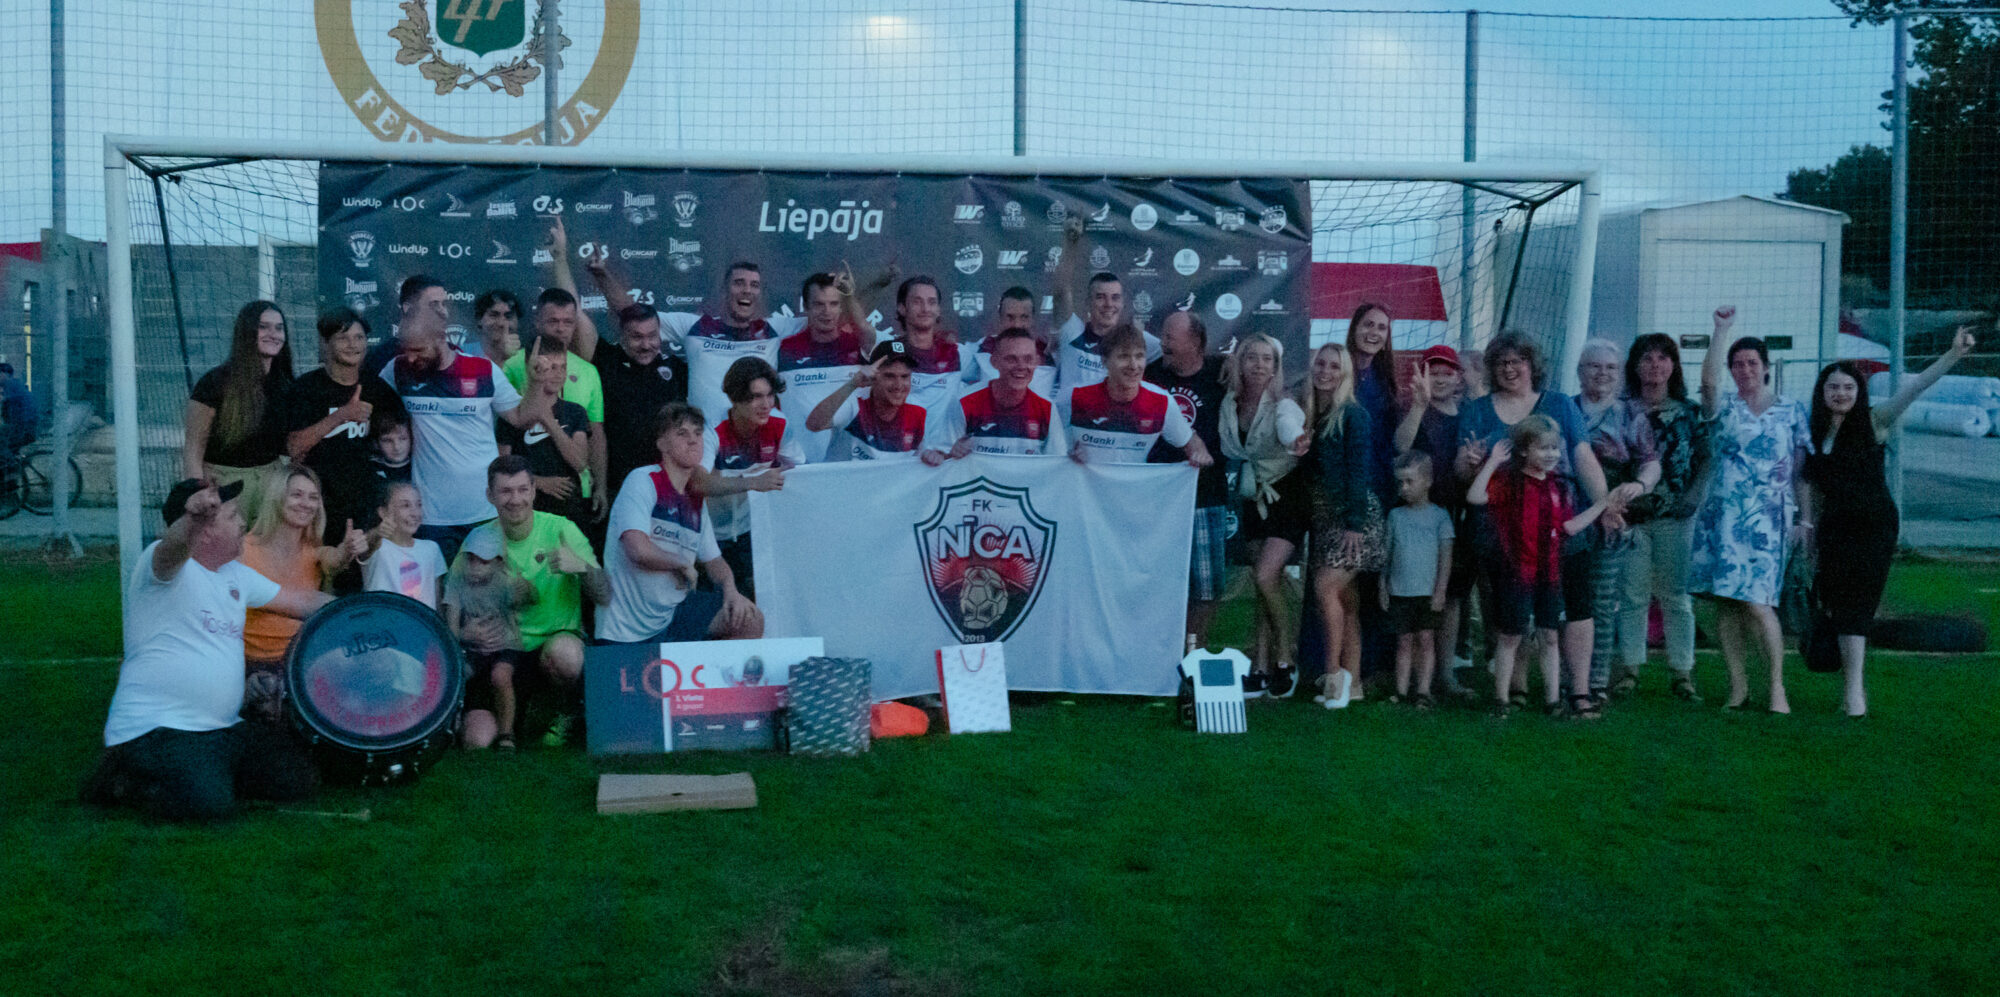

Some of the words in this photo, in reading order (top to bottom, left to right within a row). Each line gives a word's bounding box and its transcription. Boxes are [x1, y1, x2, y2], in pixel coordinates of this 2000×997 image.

[342, 197, 382, 209] WindUp
[393, 196, 425, 212] LOC
[759, 199, 883, 241] Liepāja
[388, 243, 429, 256] WindUp
[439, 242, 471, 259] LOC
[703, 340, 736, 352] Otanki
[794, 371, 827, 383] Otanki
[406, 400, 438, 412] Otanki
[460, 404, 477, 413] .eu
[1082, 432, 1116, 446] Otanki
[971, 500, 993, 514] FK
[937, 515, 1035, 563] NĪCA
